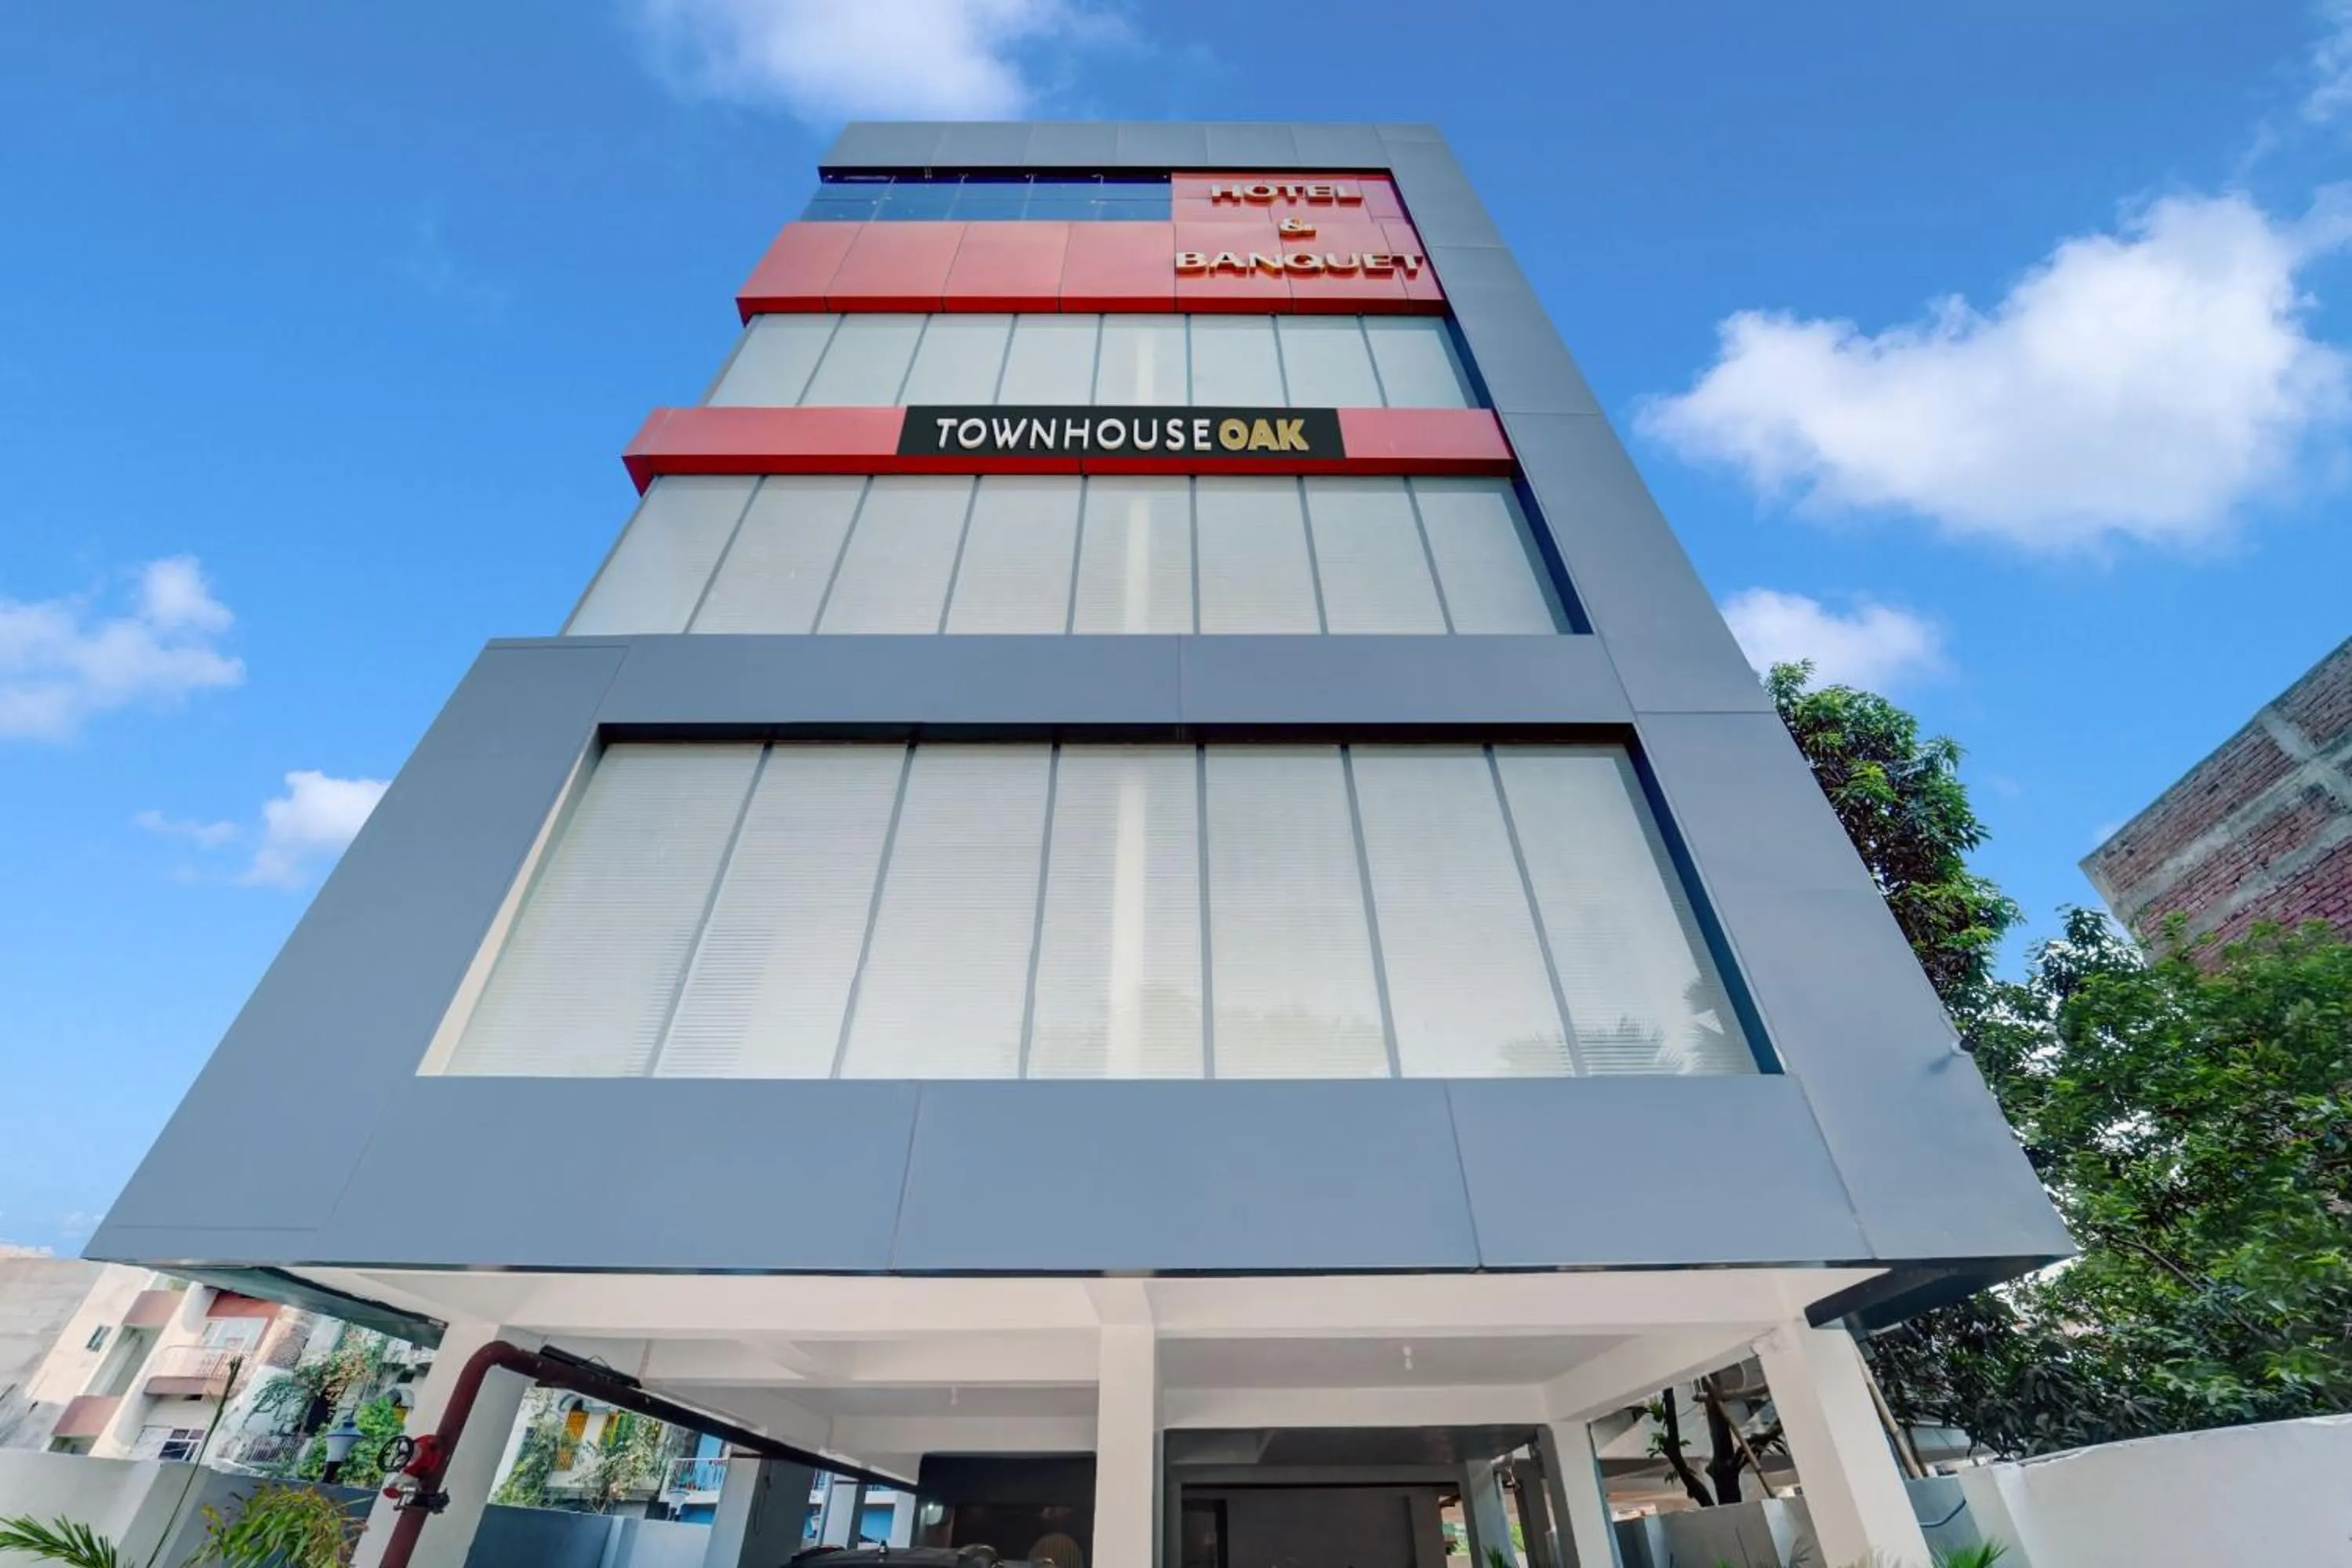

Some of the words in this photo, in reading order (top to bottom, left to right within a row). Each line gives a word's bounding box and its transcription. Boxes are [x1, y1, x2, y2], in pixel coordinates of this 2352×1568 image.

[1210, 184, 1363, 204] HOTEL
[1279, 218, 1316, 237] &
[1175, 252, 1423, 276] BANQUET
